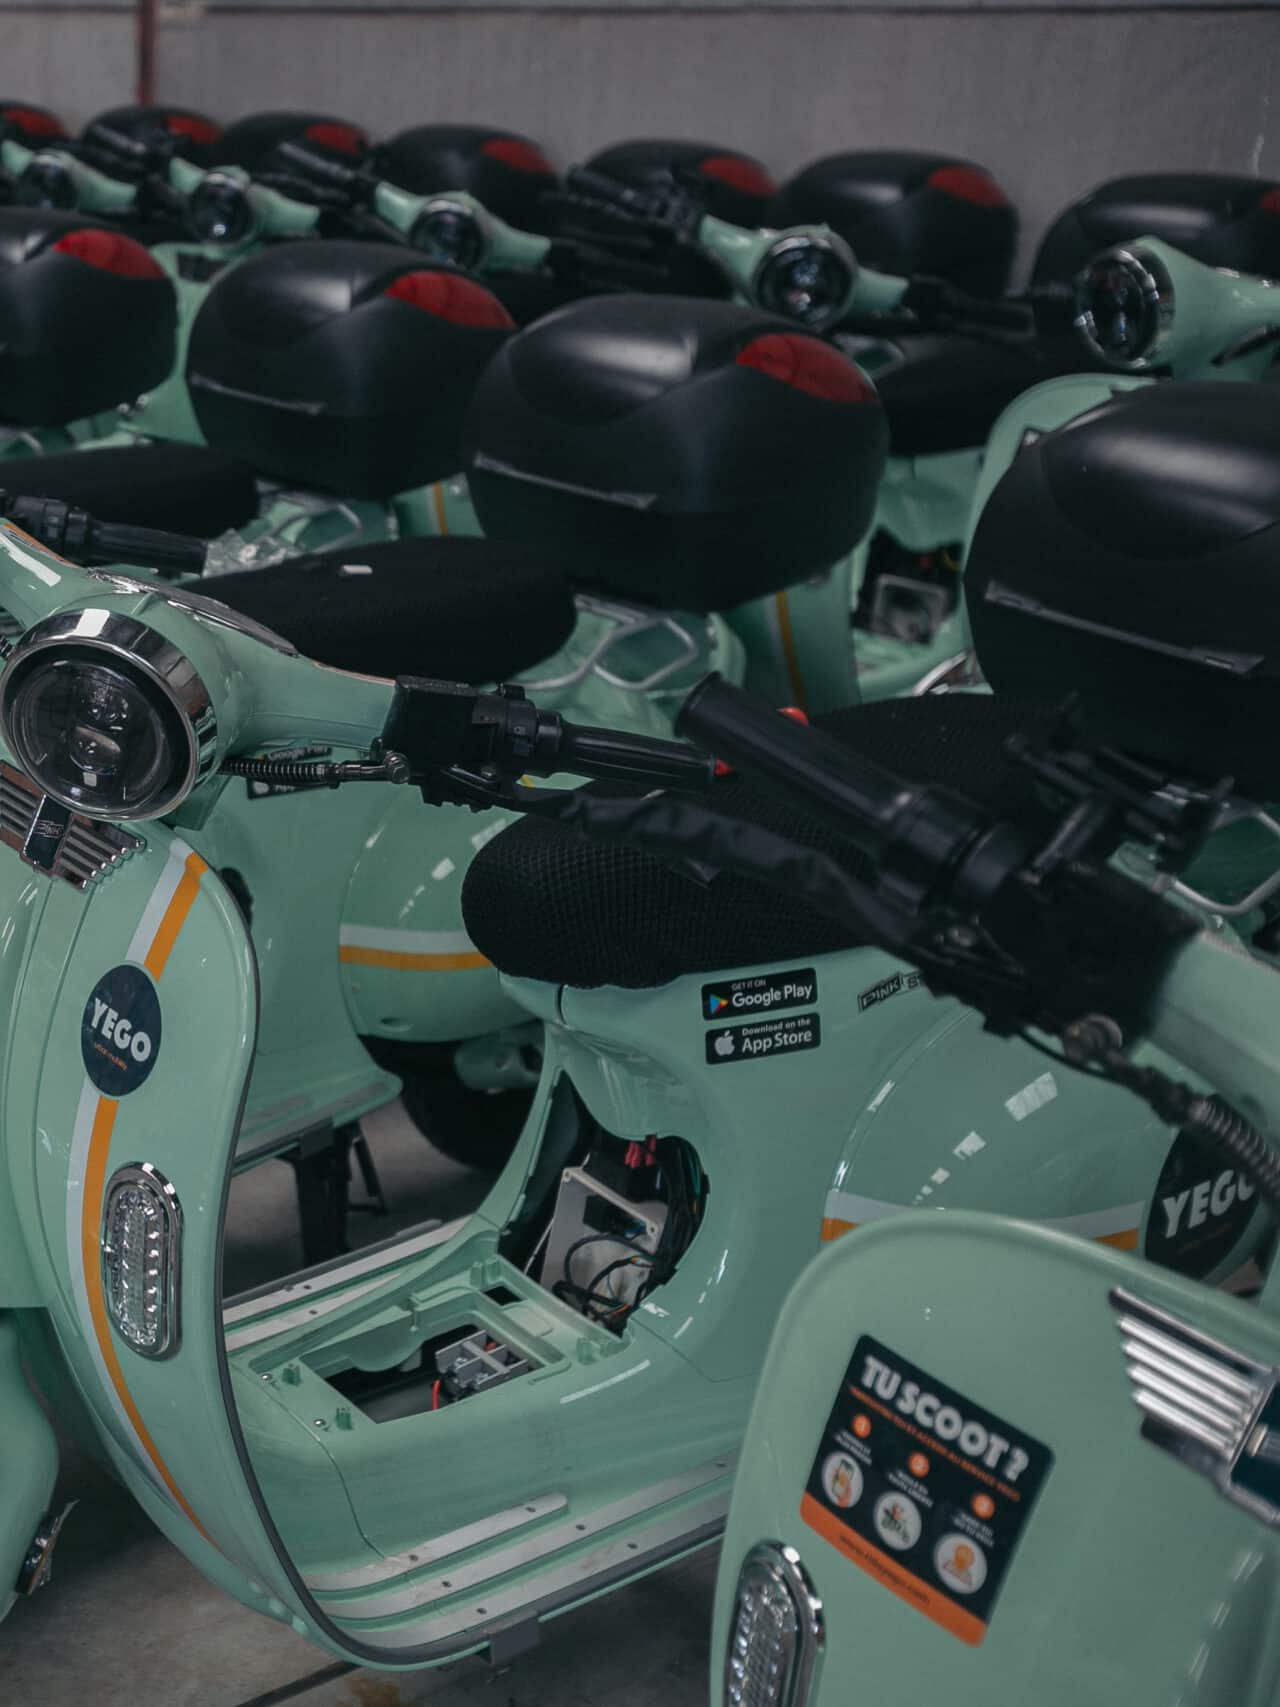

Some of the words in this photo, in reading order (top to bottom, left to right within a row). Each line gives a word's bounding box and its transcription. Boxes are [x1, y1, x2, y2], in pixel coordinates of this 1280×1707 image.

[731, 981, 746, 992] GET
[746, 980, 753, 990] IT
[754, 979, 767, 989] ON
[732, 989, 782, 1008] Google
[783, 983, 813, 1000] Play
[862, 976, 900, 1008] PINK
[89, 998, 152, 1063] YEGO
[742, 1021, 783, 1036] Download
[785, 1021, 796, 1030] on
[797, 1017, 811, 1028] the
[742, 1036, 772, 1054] App
[774, 1029, 813, 1048] Store
[861, 1355, 902, 1400] TU
[896, 1383, 1011, 1469] SCOOT
